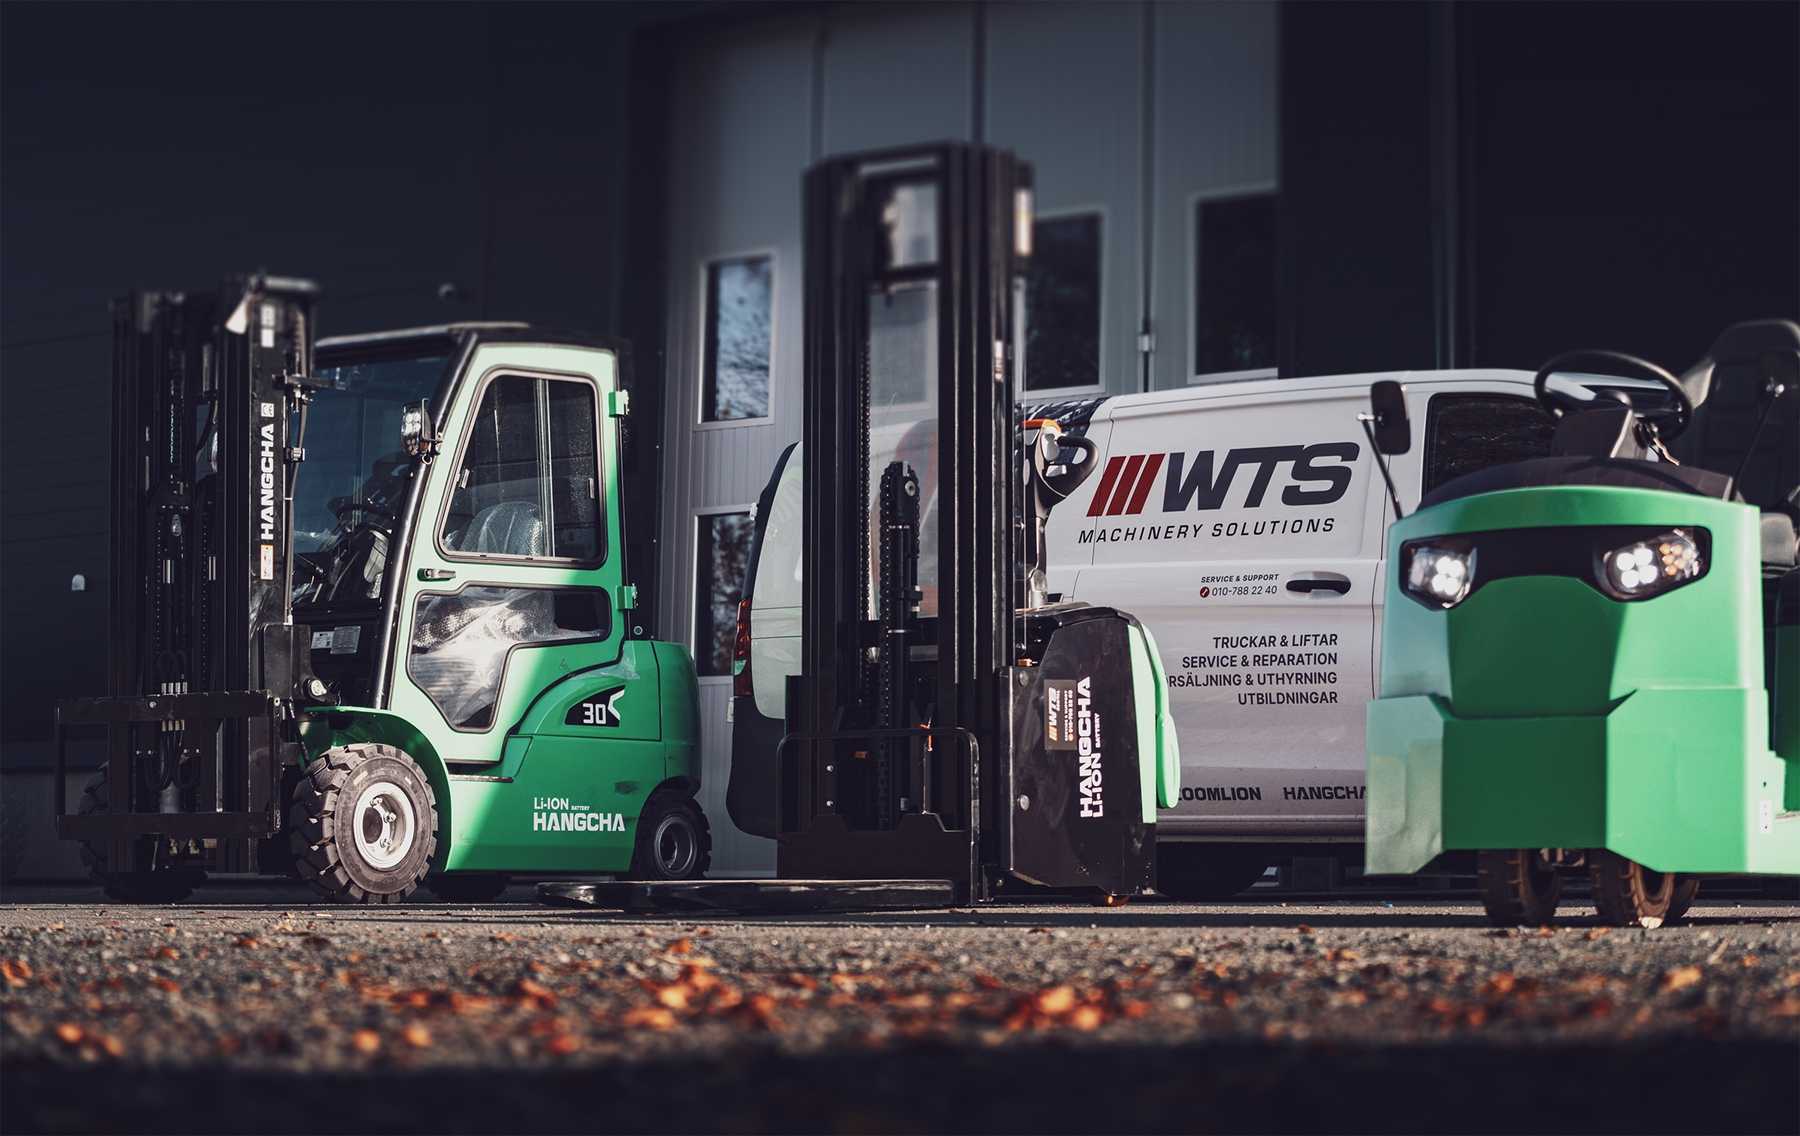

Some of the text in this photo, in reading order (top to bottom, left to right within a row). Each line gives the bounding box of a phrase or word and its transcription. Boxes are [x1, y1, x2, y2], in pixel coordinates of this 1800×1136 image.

[260, 423, 274, 540] HANGCHA
[1162, 441, 1360, 513] WTS
[1078, 517, 1335, 544] MACHINERY SOLUTIONS
[1200, 575, 1234, 583] SERVICE
[1242, 573, 1280, 582] SUPPORT
[1211, 585, 1278, 597] 010-788 22 40
[1213, 633, 1338, 649] TRUCKAR & LIFTAR
[1182, 652, 1338, 668] SERVICE & REPARATION
[1166, 671, 1337, 688] RSÄLJNING & UTHYRNING
[1238, 691, 1338, 705] UTBILDNINGAR
[583, 703, 607, 725] 30
[1077, 676, 1093, 818] HANGCHA
[1178, 786, 1261, 801] OOMLION
[534, 797, 569, 810] Li-ION
[533, 812, 625, 832] HANGCHA
